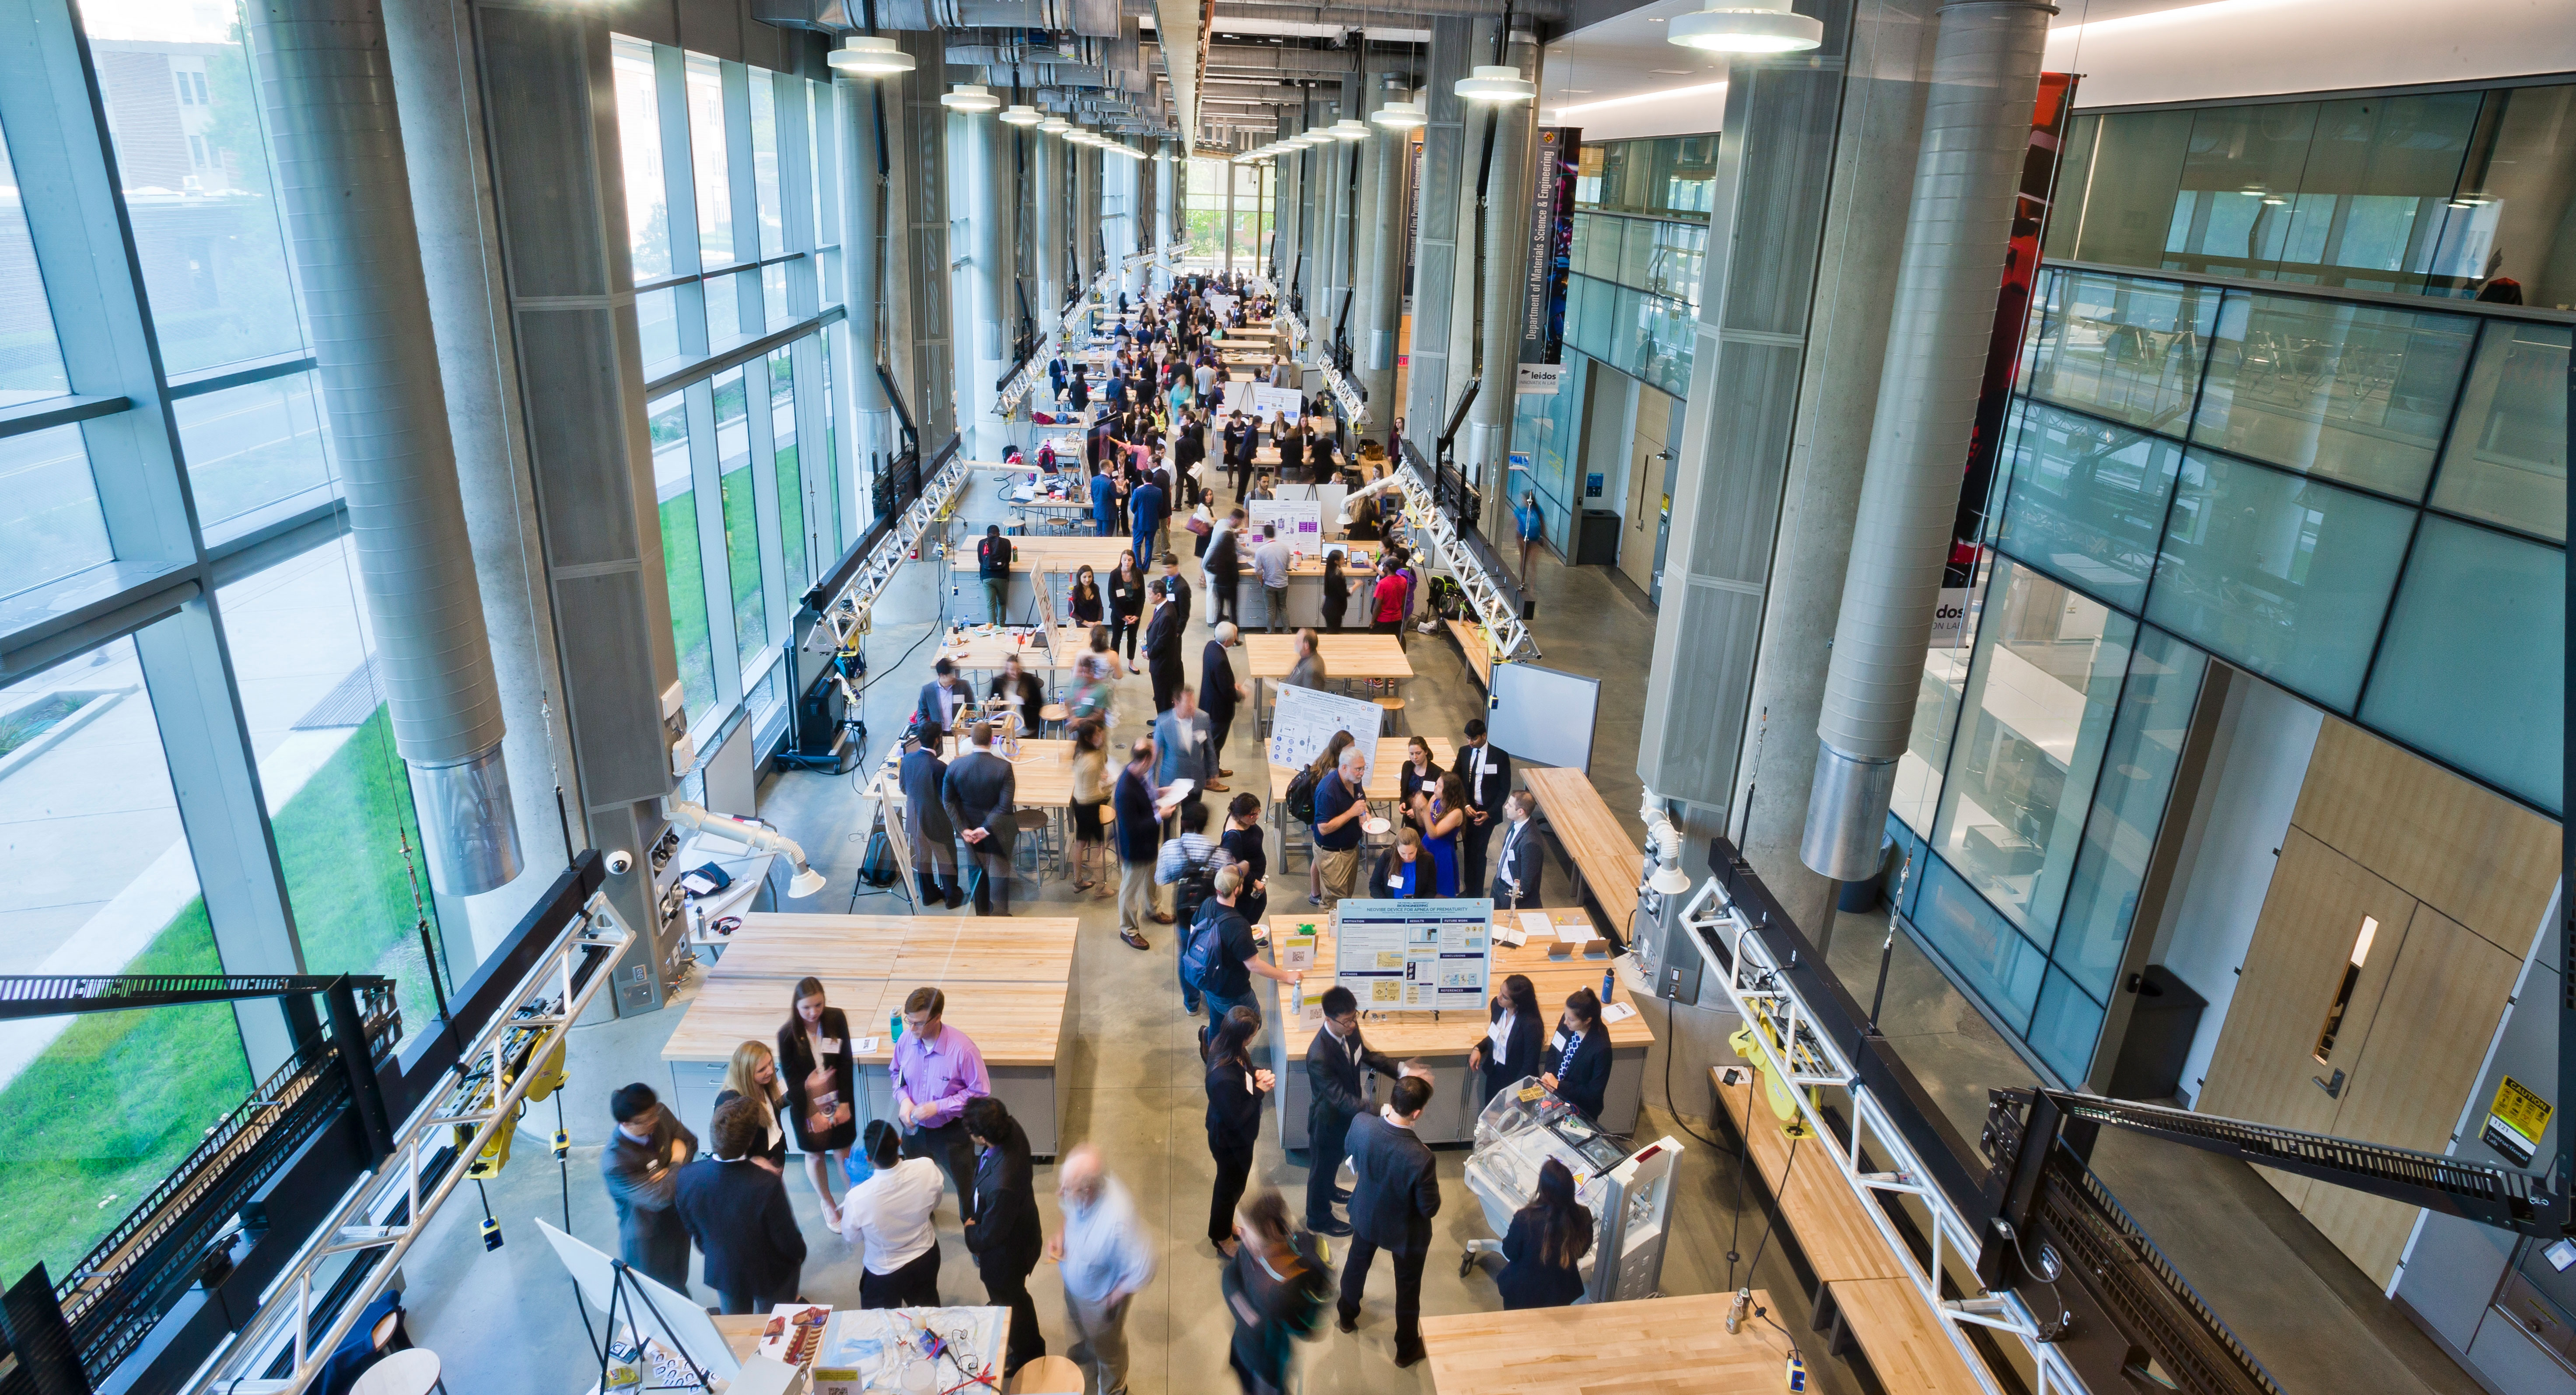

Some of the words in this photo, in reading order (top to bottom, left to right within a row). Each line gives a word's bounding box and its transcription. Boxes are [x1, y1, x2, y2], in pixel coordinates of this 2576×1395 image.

[1537, 151, 1554, 199] Engineering
[1534, 210, 1547, 241] Science
[1531, 243, 1544, 282] Materials
[1526, 294, 1540, 340] Department
[1531, 371, 1556, 380] leidos
[1762, 911, 1767, 923] A
[2510, 1082, 2547, 1110] CAUTION
[2494, 1120, 2510, 1133] 1121
[2486, 1136, 2498, 1146] Lab
[2488, 1130, 2528, 1161] Instructional
[2063, 1311, 2070, 1325] C
